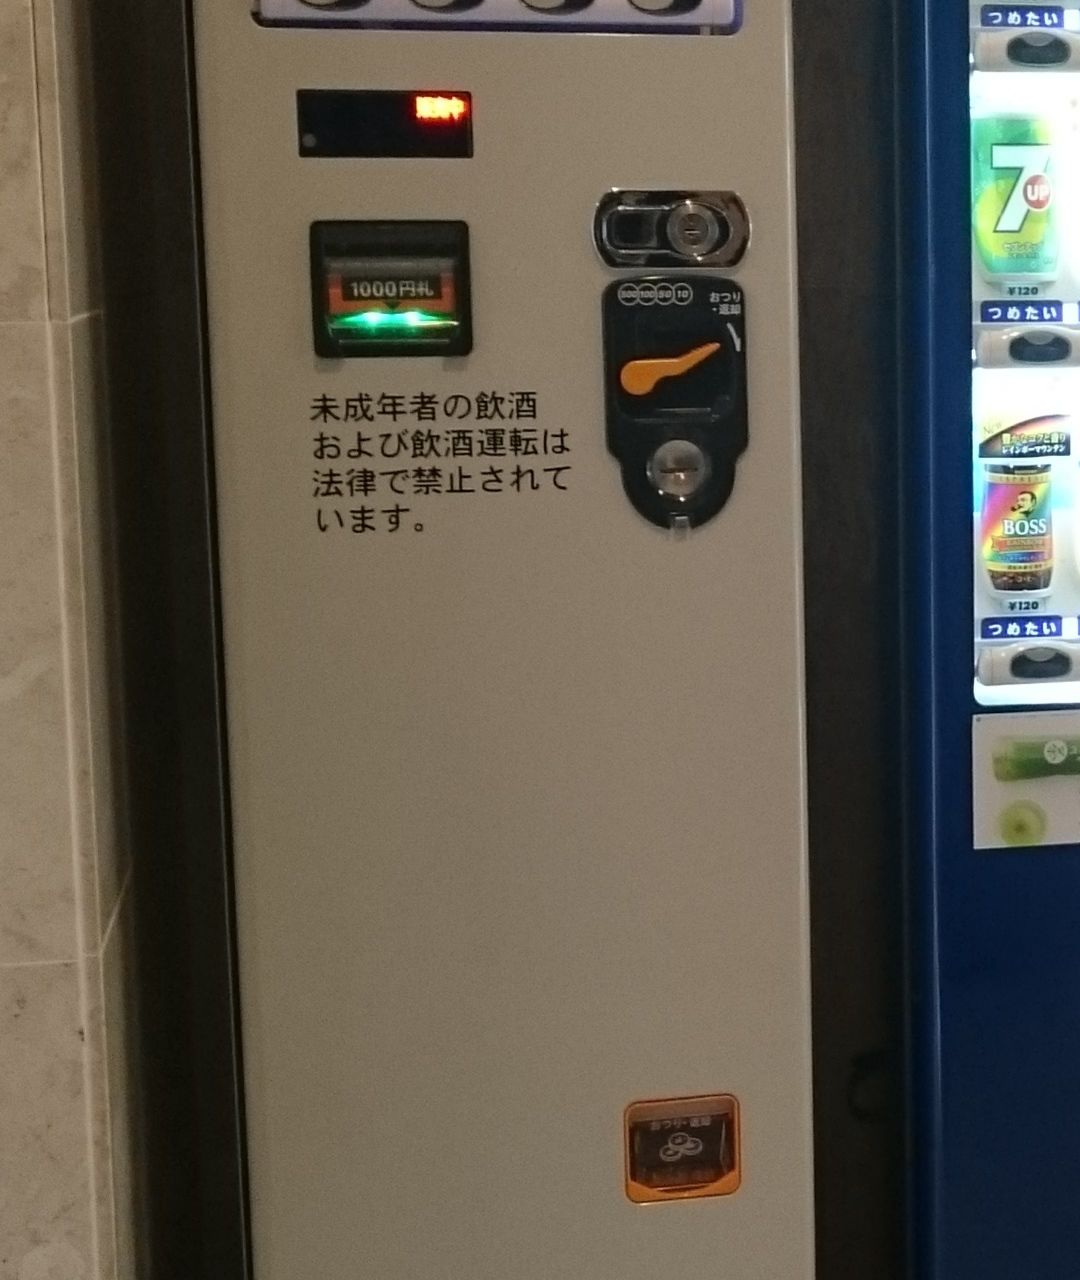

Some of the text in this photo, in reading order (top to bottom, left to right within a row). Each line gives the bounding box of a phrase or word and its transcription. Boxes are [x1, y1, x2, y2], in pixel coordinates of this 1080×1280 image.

[988, 11, 1058, 26] つめたい
[991, 143, 1052, 233] 7 UP
[351, 279, 434, 298] 1000円札
[989, 306, 1057, 320] つめたい
[309, 392, 538, 422] 未成年者の飲酒
[312, 428, 572, 461] および飲酒運転は
[312, 464, 573, 498] 法律で禁止されて
[316, 505, 427, 533] います。
[1004, 519, 1047, 536] BOSS
[989, 621, 1057, 635] つめたい
